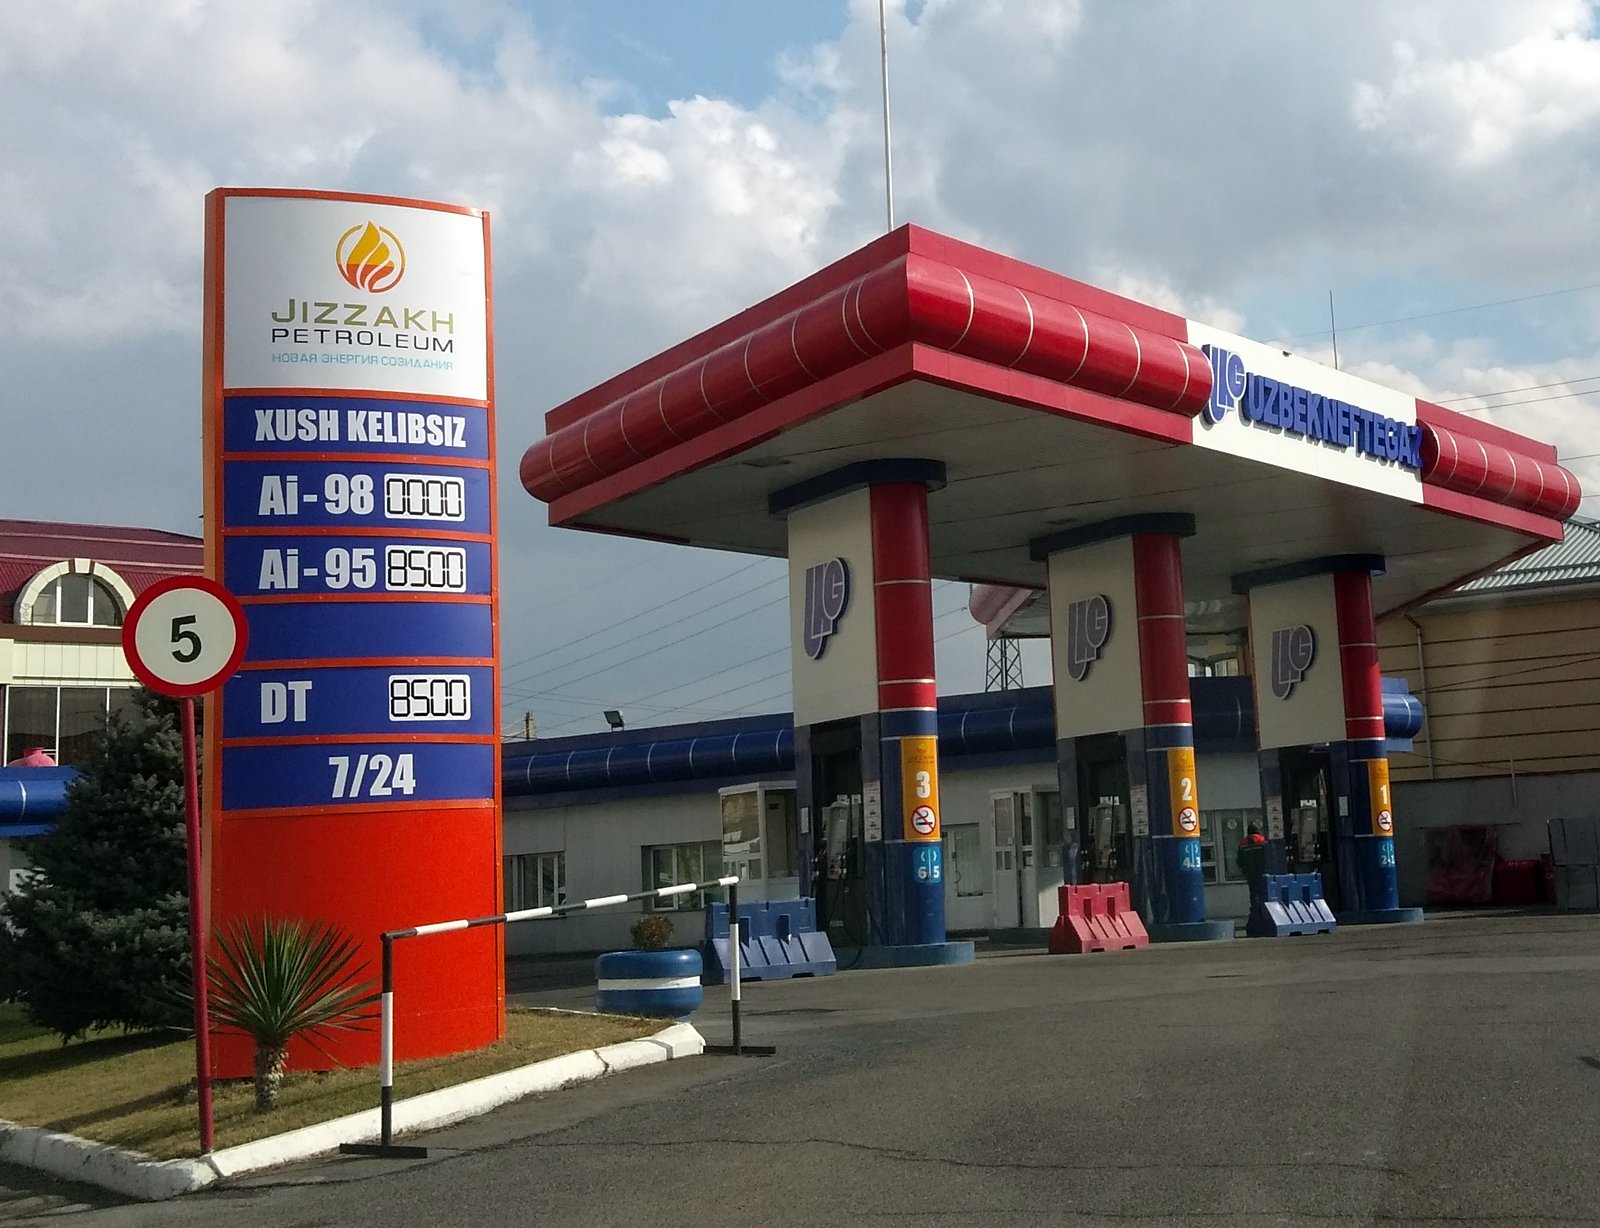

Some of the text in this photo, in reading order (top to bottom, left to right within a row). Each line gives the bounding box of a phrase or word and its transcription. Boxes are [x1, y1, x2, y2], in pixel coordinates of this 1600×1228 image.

[271, 298, 454, 334] JIZZAKH
[271, 328, 454, 353] PETROLEUM
[271, 353, 453, 370] НОВАЯ ЭНЕРГИЯ СОЗИДАНИЯ
[254, 408, 467, 447] XUSH KELIBSIZ
[1243, 372, 1422, 468] UZBEKNEFTEGAZ
[386, 478, 462, 518] 0000
[387, 549, 464, 588] 8500
[170, 614, 202, 663] 5
[259, 678, 467, 724] DT 8500
[328, 753, 416, 798] 7/24
[915, 770, 931, 799] 3
[1180, 777, 1192, 801] 2
[1379, 784, 1388, 805] 1
[917, 865, 940, 880] 6 5
